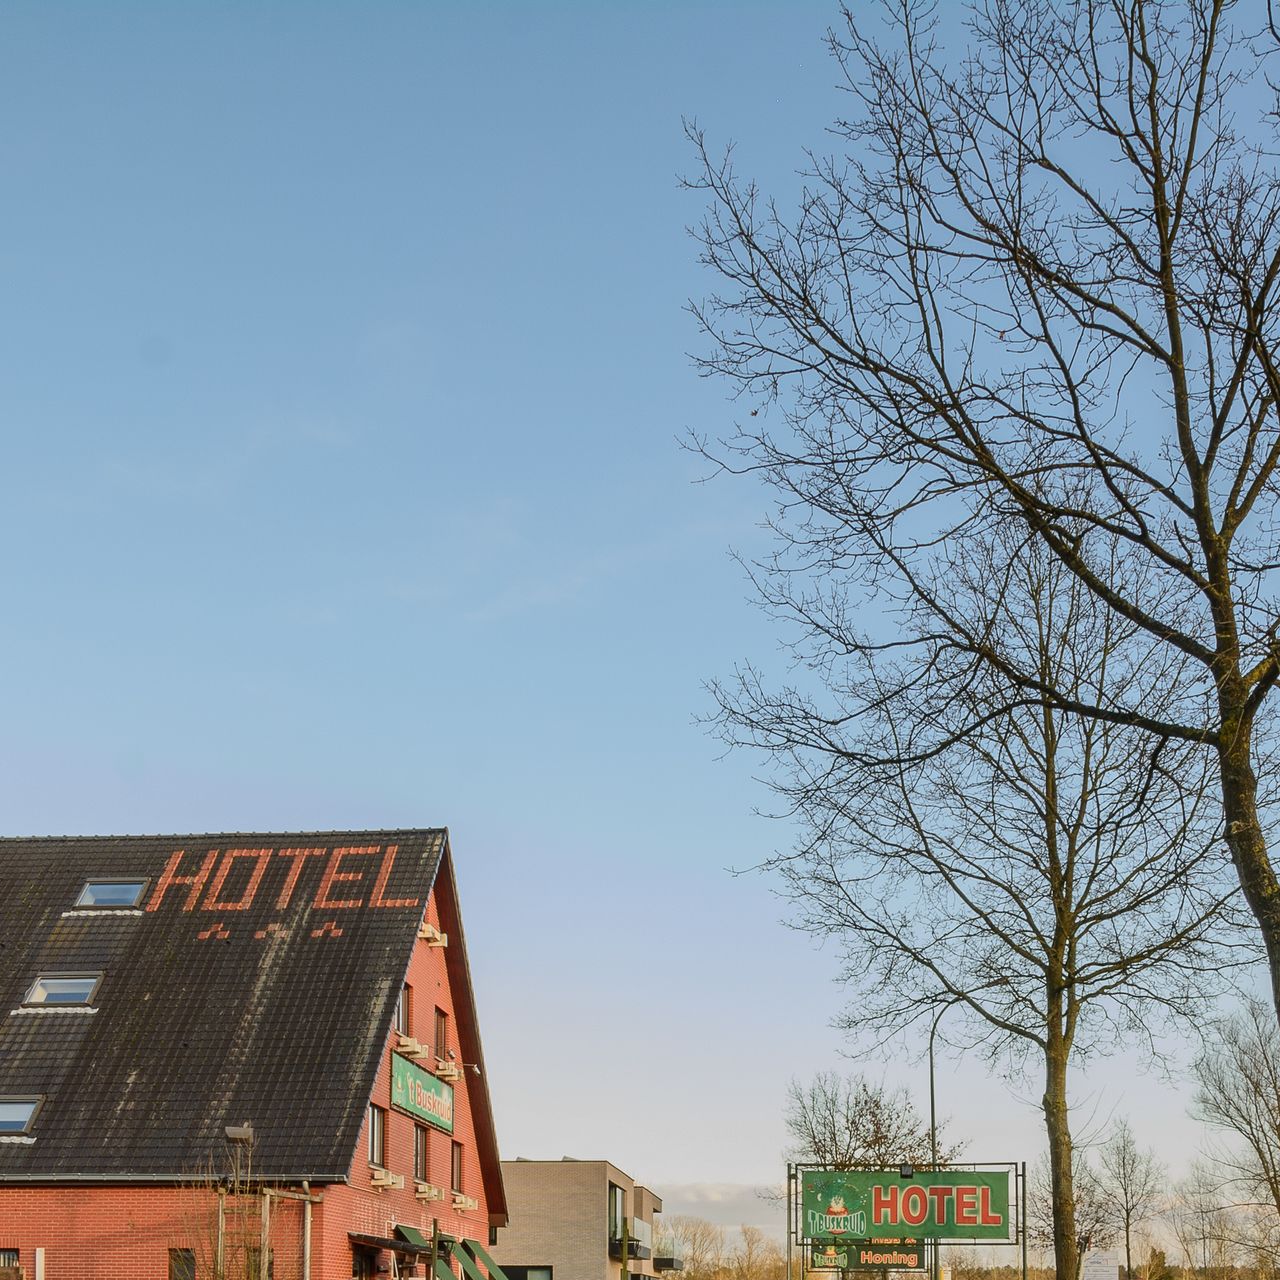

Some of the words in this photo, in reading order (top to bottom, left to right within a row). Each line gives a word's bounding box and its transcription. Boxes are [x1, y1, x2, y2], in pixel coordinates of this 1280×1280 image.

[145, 846, 419, 912] HOTEL
[871, 1185, 1003, 1226] HOTEL
[861, 1251, 918, 1267] Honing
